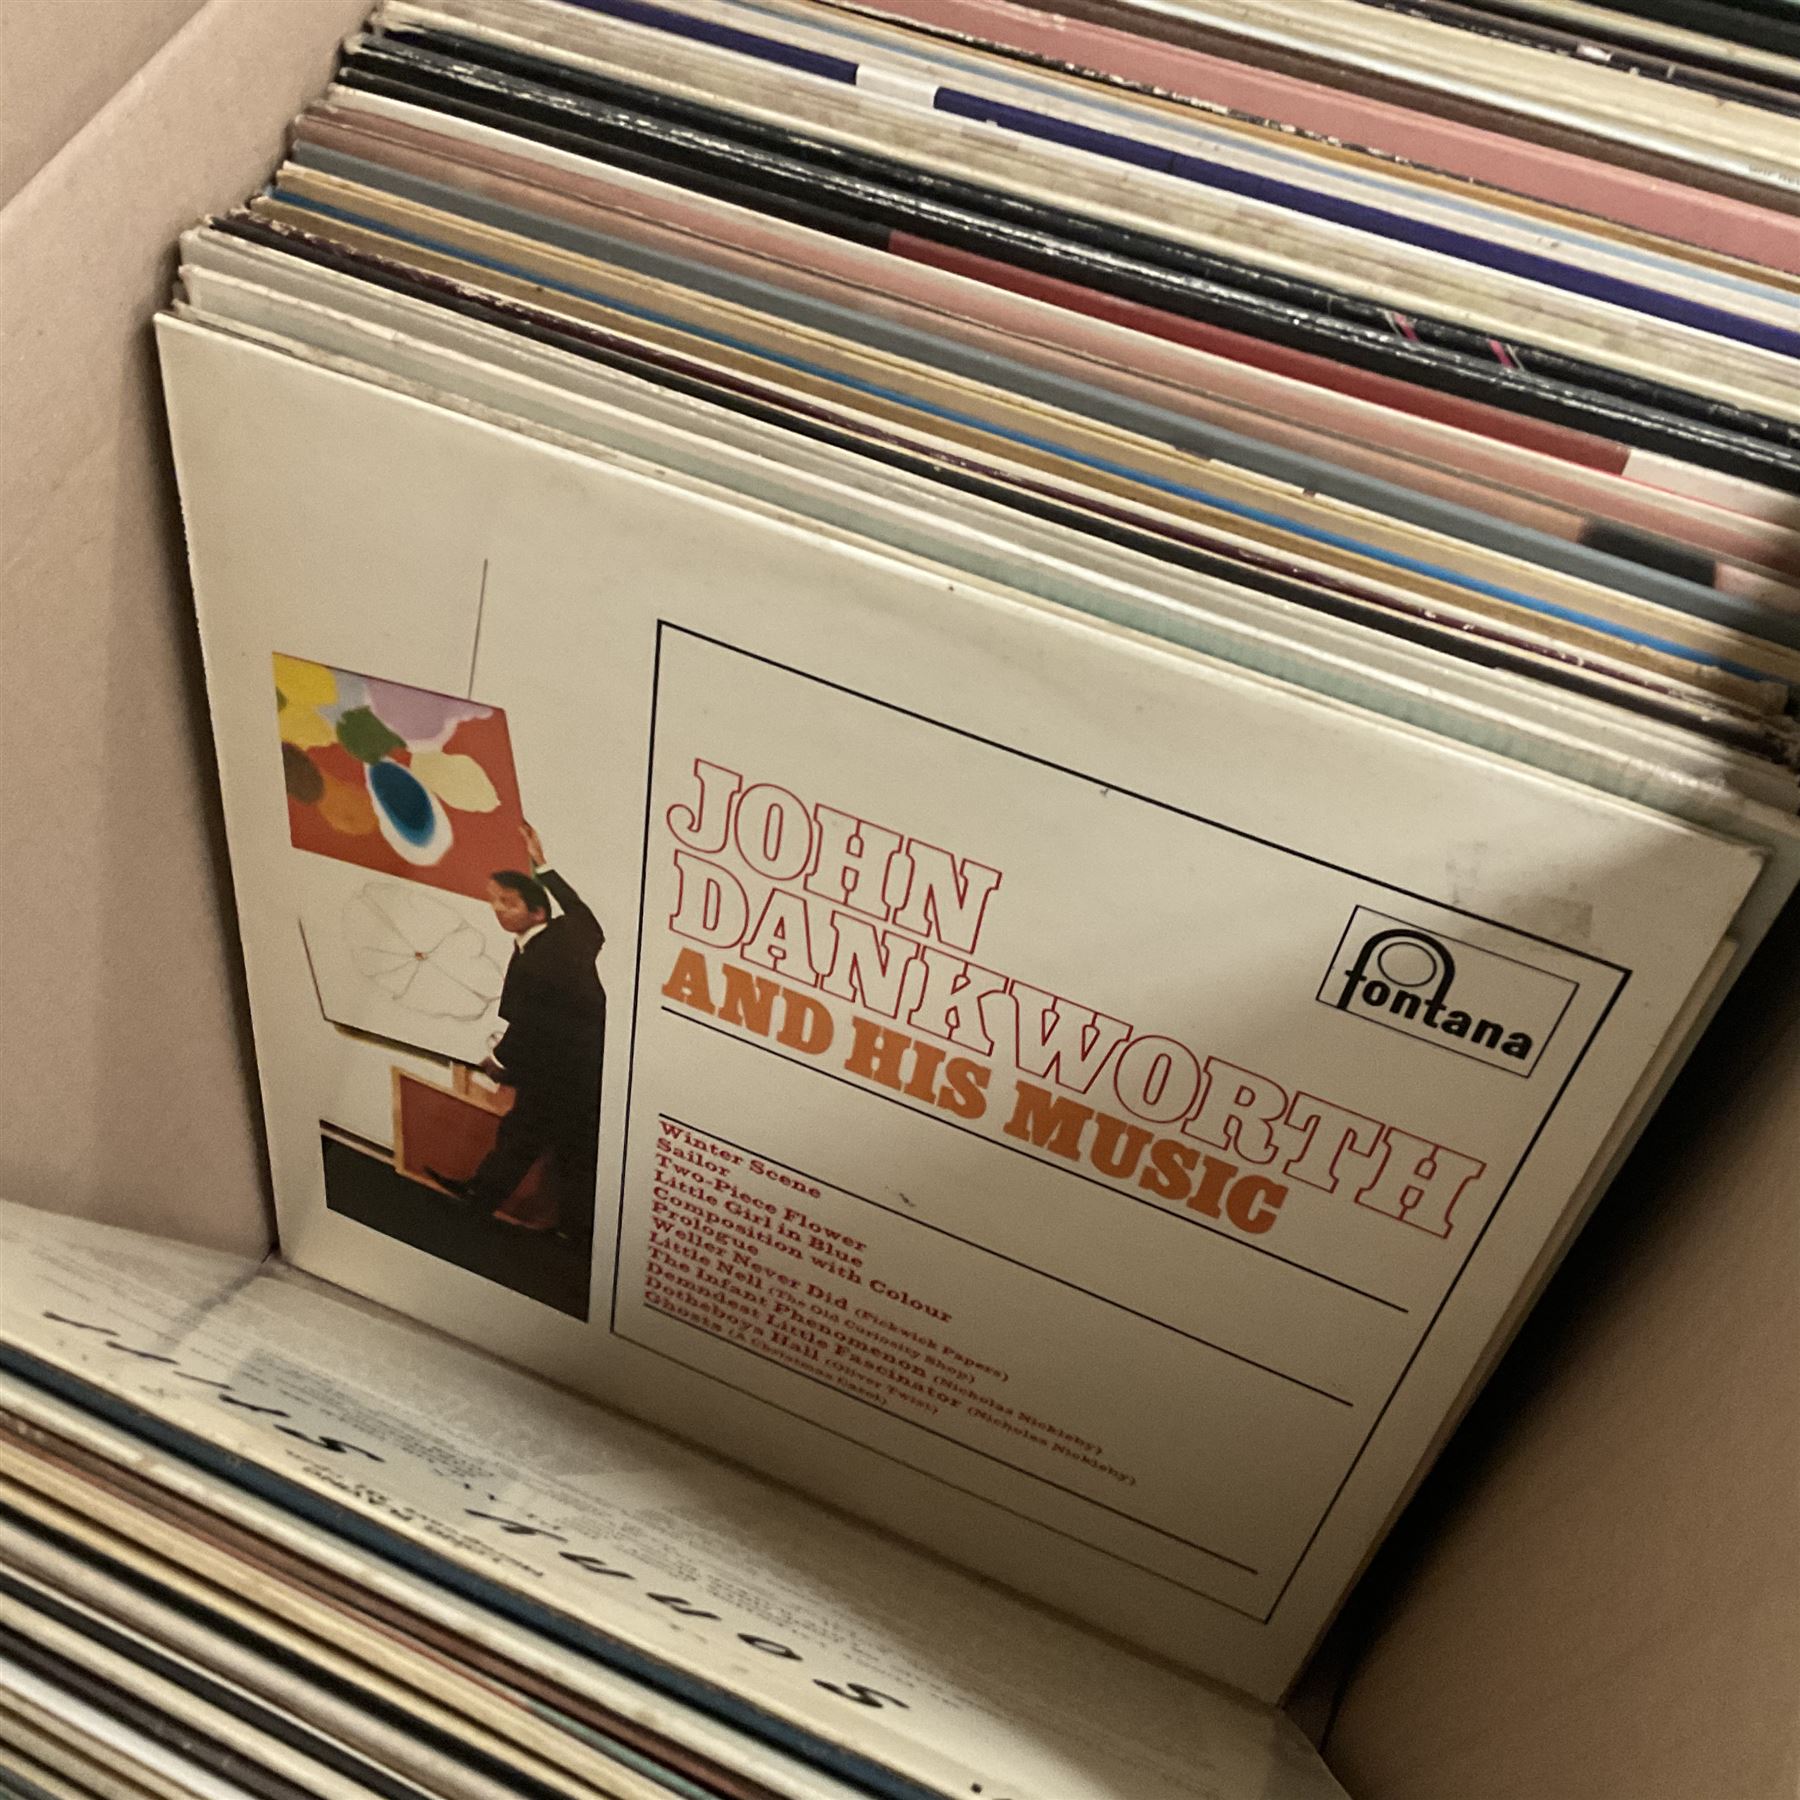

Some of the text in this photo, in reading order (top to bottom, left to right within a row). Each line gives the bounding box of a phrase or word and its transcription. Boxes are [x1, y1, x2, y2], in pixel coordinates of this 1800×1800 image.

[666, 757, 1003, 956] JOHN
[668, 848, 1487, 1240] DANKWORTH
[1337, 929, 1533, 1061] fontana
[661, 947, 1290, 1235] AND HIS MUSIC
[656, 1153, 866, 1252] Two-Piece Flower
[657, 1138, 730, 1176] Sailor
[660, 1121, 820, 1198] Winter Scene
[650, 1231, 710, 1266] Little
[717, 1260, 762, 1289] Nell
[652, 1200, 758, 1255] Prologue
[654, 1187, 951, 1322] Composition with Colour
[655, 1170, 863, 1267] Little Girl in Blue
[645, 1276, 764, 1336] Dotheboys
[771, 1331, 818, 1361] Hall
[648, 1245, 690, 1272] The
[697, 1267, 767, 1307] Infant
[773, 1301, 926, 1377] Phenomenon
[652, 1216, 1008, 1382] Weller Never Did (Pickwick Papers)
[766, 1314, 829, 1349] Little
[833, 1344, 961, 1407] Fascinator
